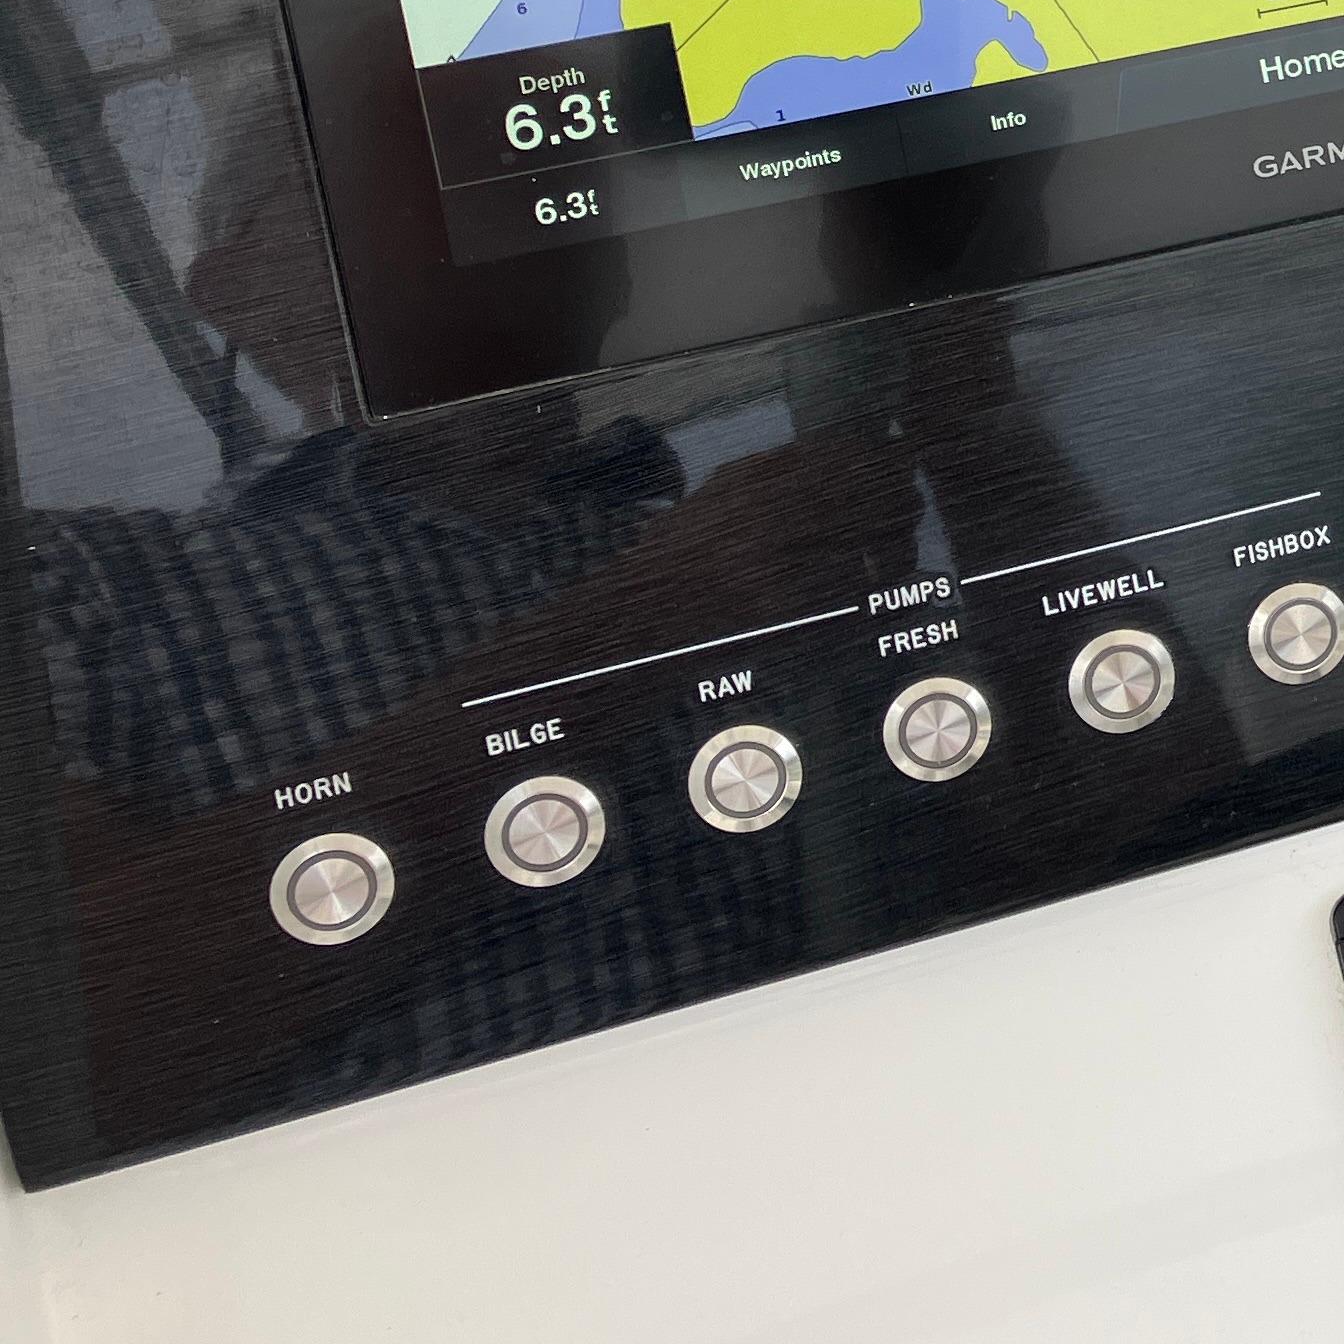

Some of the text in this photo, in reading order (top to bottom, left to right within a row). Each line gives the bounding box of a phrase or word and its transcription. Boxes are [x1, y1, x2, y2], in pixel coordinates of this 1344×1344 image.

[519, 67, 585, 96] Depth
[991, 110, 1027, 131] Info
[739, 147, 842, 182] Waypoints
[1232, 525, 1332, 567] FISHBOX
[867, 576, 951, 616] PUMPS
[1042, 569, 1164, 617] LIVEWELL
[878, 618, 959, 657] FRESH
[698, 670, 754, 703] RAW
[485, 718, 565, 756] BILGE
[274, 771, 352, 810] HORN
